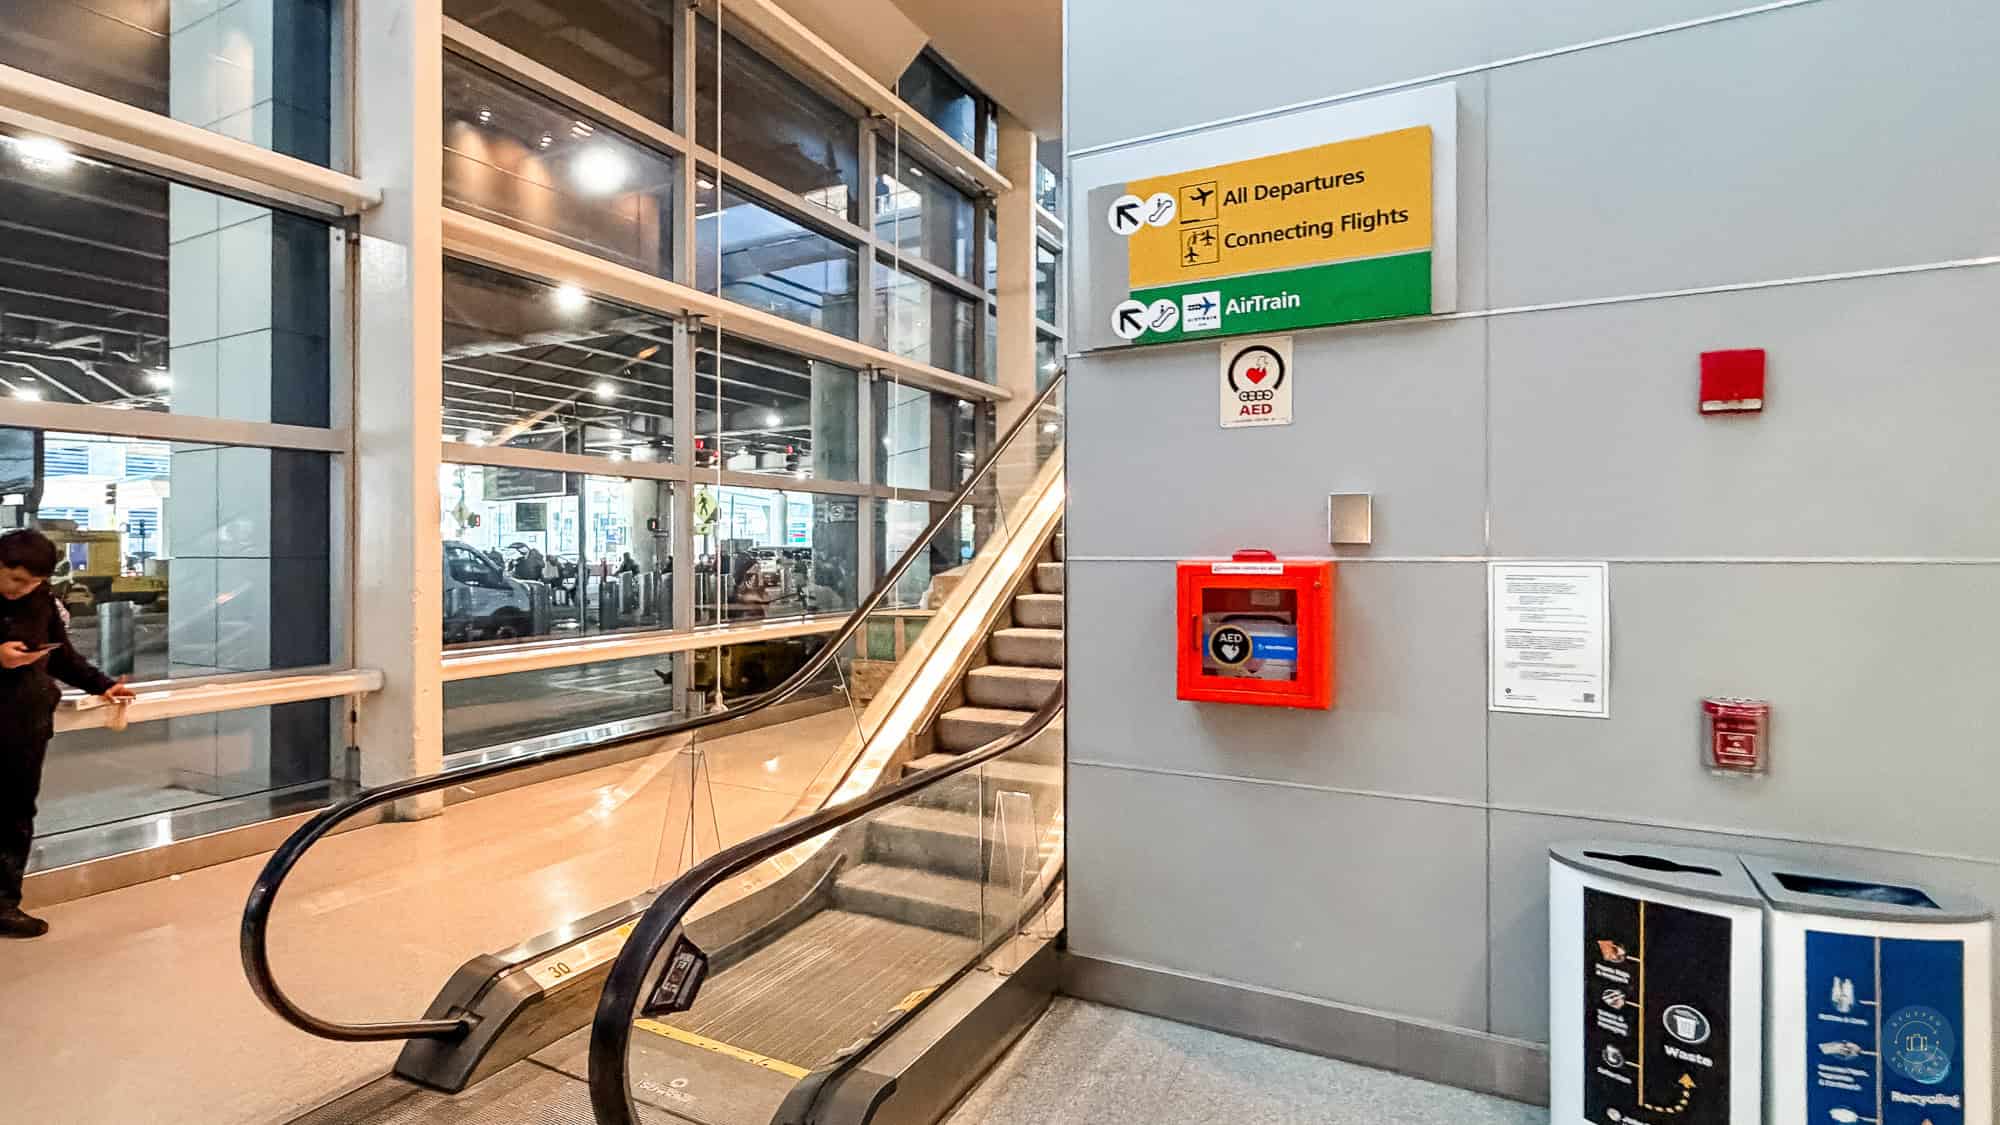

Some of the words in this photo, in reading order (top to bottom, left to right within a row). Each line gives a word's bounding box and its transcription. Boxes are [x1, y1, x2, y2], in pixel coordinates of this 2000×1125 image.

[1223, 187, 1247, 206] All
[1254, 170, 1365, 200] Departures
[1224, 221, 1333, 248] Connecting
[1341, 208, 1408, 232] Flights
[1225, 291, 1301, 315] AirTrain
[1239, 403, 1273, 416] AED
[1219, 633, 1243, 643] AED
[547, 962, 571, 978] 30
[1663, 1044, 1713, 1067] Waste
